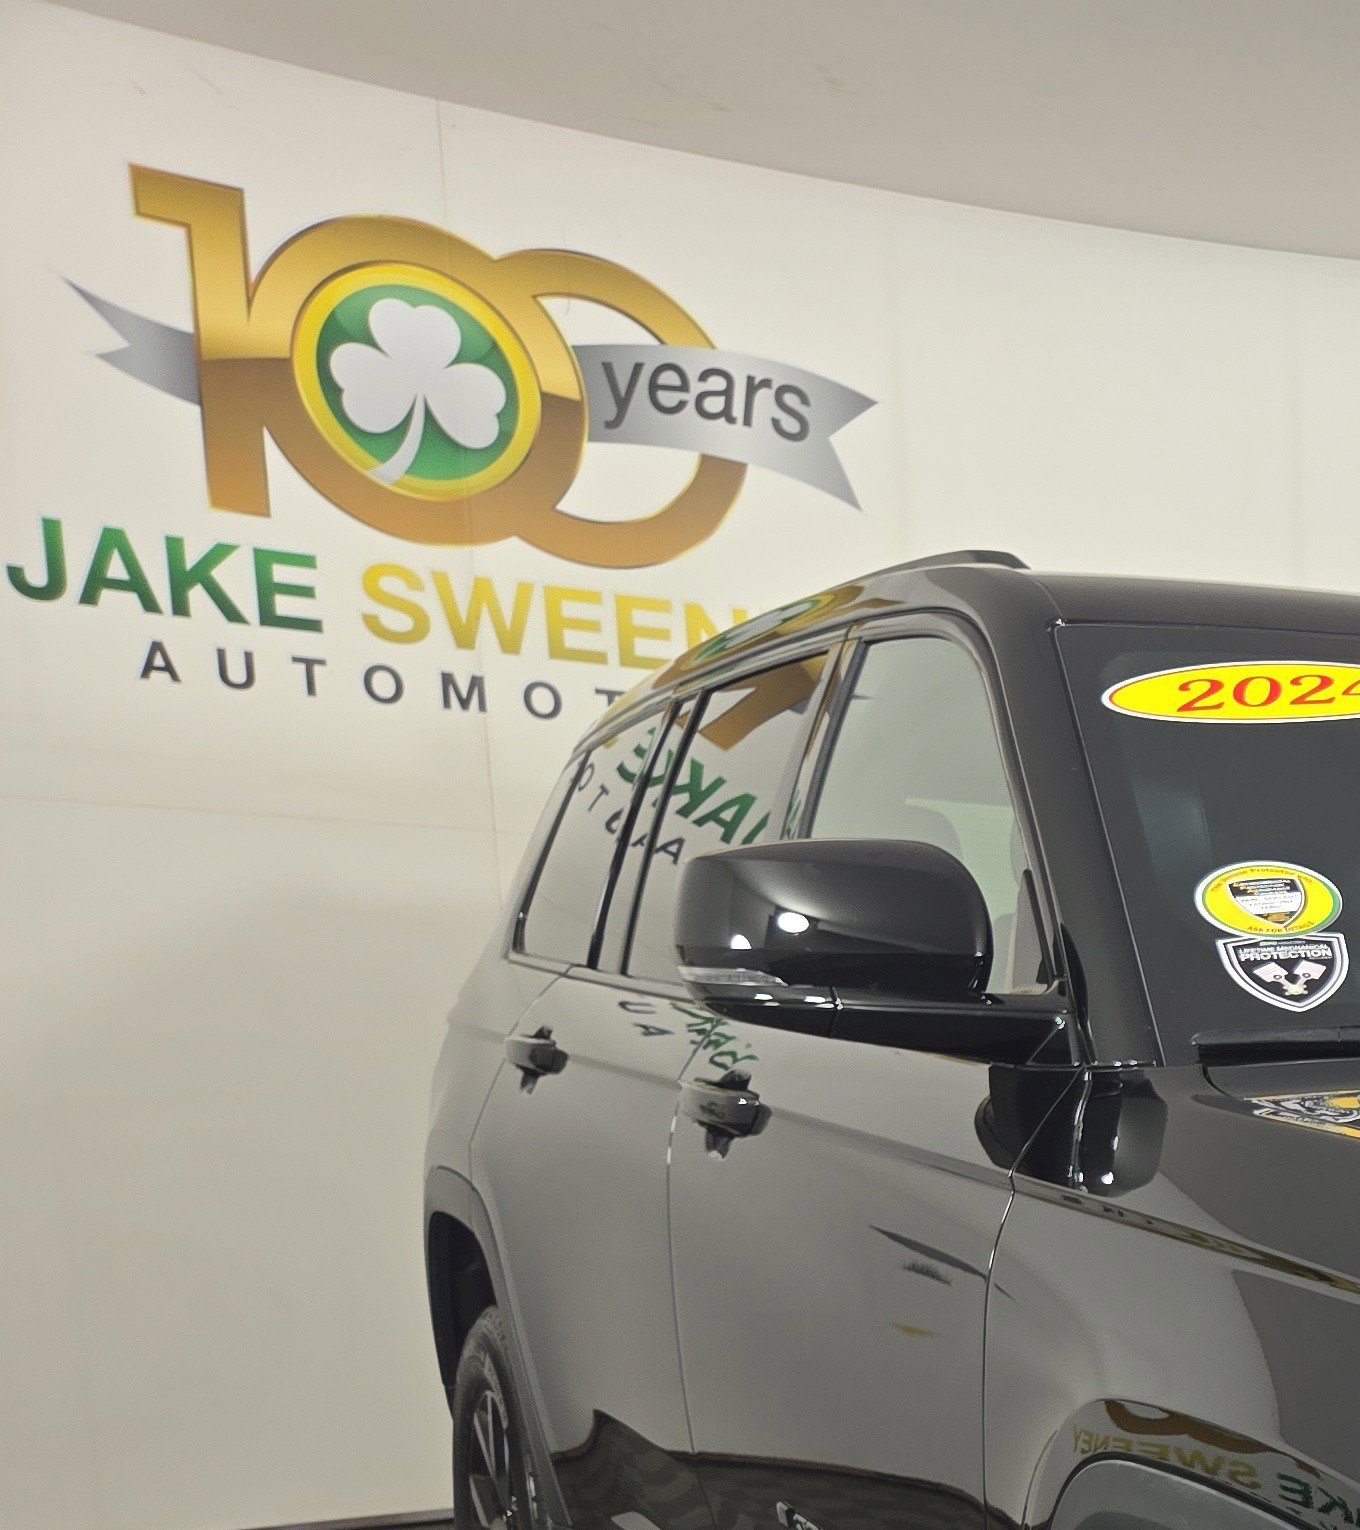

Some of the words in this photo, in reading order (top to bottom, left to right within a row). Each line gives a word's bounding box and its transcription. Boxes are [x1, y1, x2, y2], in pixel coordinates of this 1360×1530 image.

[128, 163, 748, 568] 100
[602, 358, 812, 443] years
[5, 516, 324, 634] JAKE
[1239, 948, 1333, 962] PROTECTION
